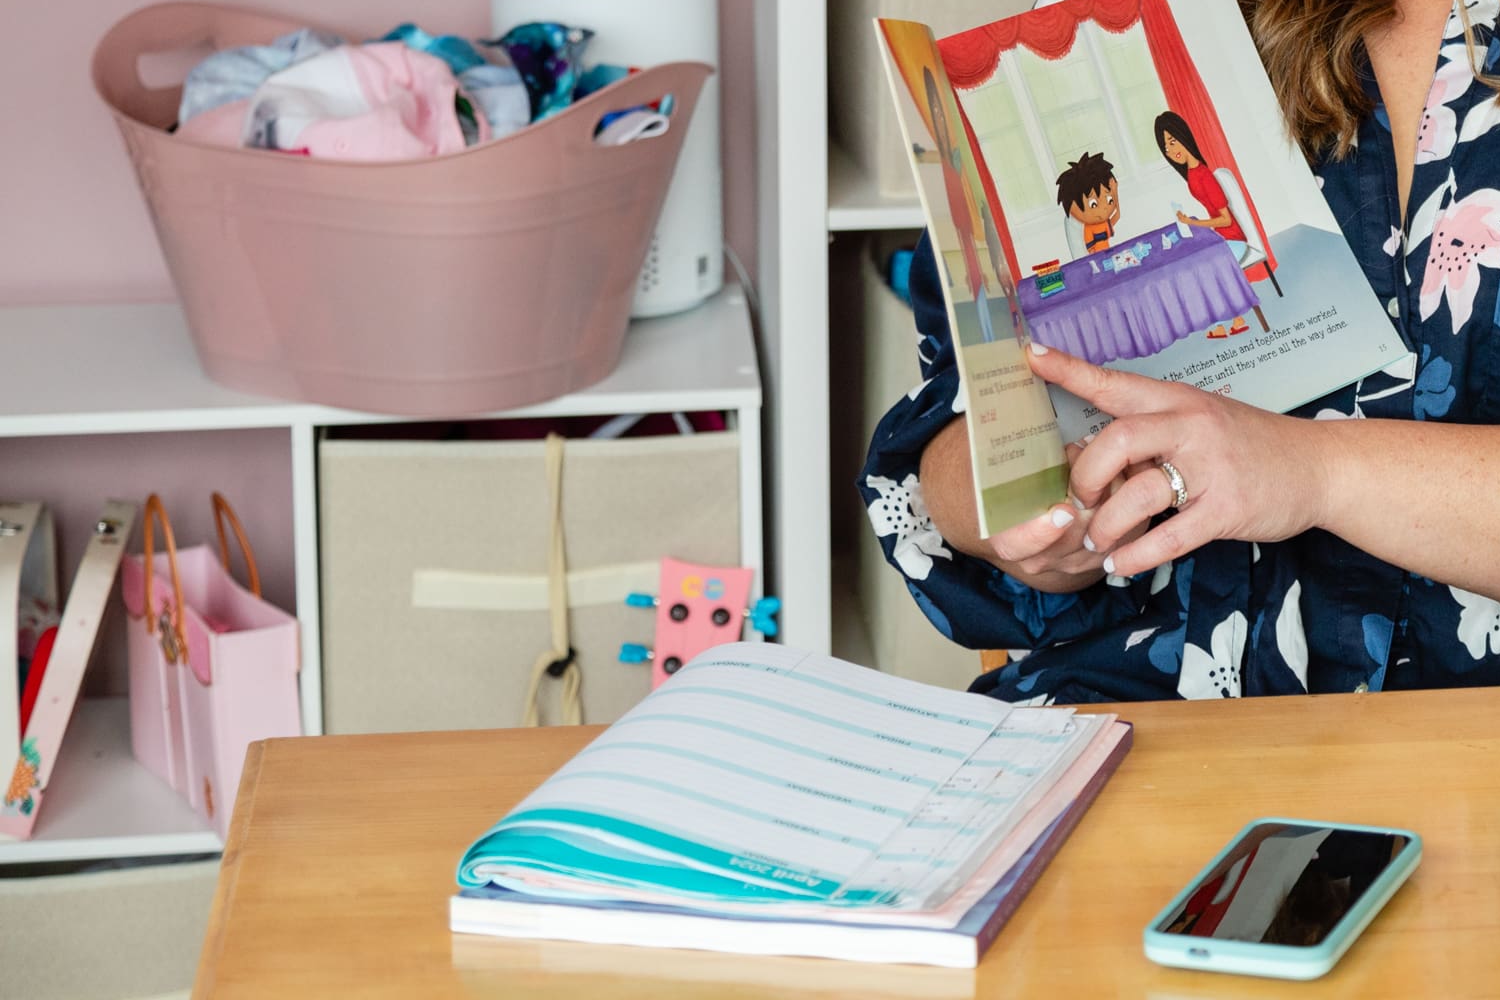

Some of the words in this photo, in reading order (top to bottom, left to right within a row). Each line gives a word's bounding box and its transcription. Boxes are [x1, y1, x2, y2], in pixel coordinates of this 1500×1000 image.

[1183, 358, 1216, 377] kitchen
[1216, 347, 1239, 364] table
[1238, 340, 1256, 355] and
[1254, 327, 1292, 347] together
[1292, 320, 1307, 332] we
[1305, 305, 1338, 327] worked
[1214, 364, 1237, 381] until
[1235, 358, 1257, 374] they
[1256, 348, 1279, 364] were
[1278, 341, 1292, 355] all
[1291, 337, 1308, 350] the
[1307, 329, 1326, 343] way
[886, 701, 939, 719] SATURDAY
[873, 732, 912, 747] FRIDAY
[827, 756, 882, 775] THURSDAY
[786, 782, 852, 803] WEDNESDAY
[773, 818, 820, 836] TUESDAY
[728, 855, 772, 875] 2024
[771, 867, 822, 888] April
